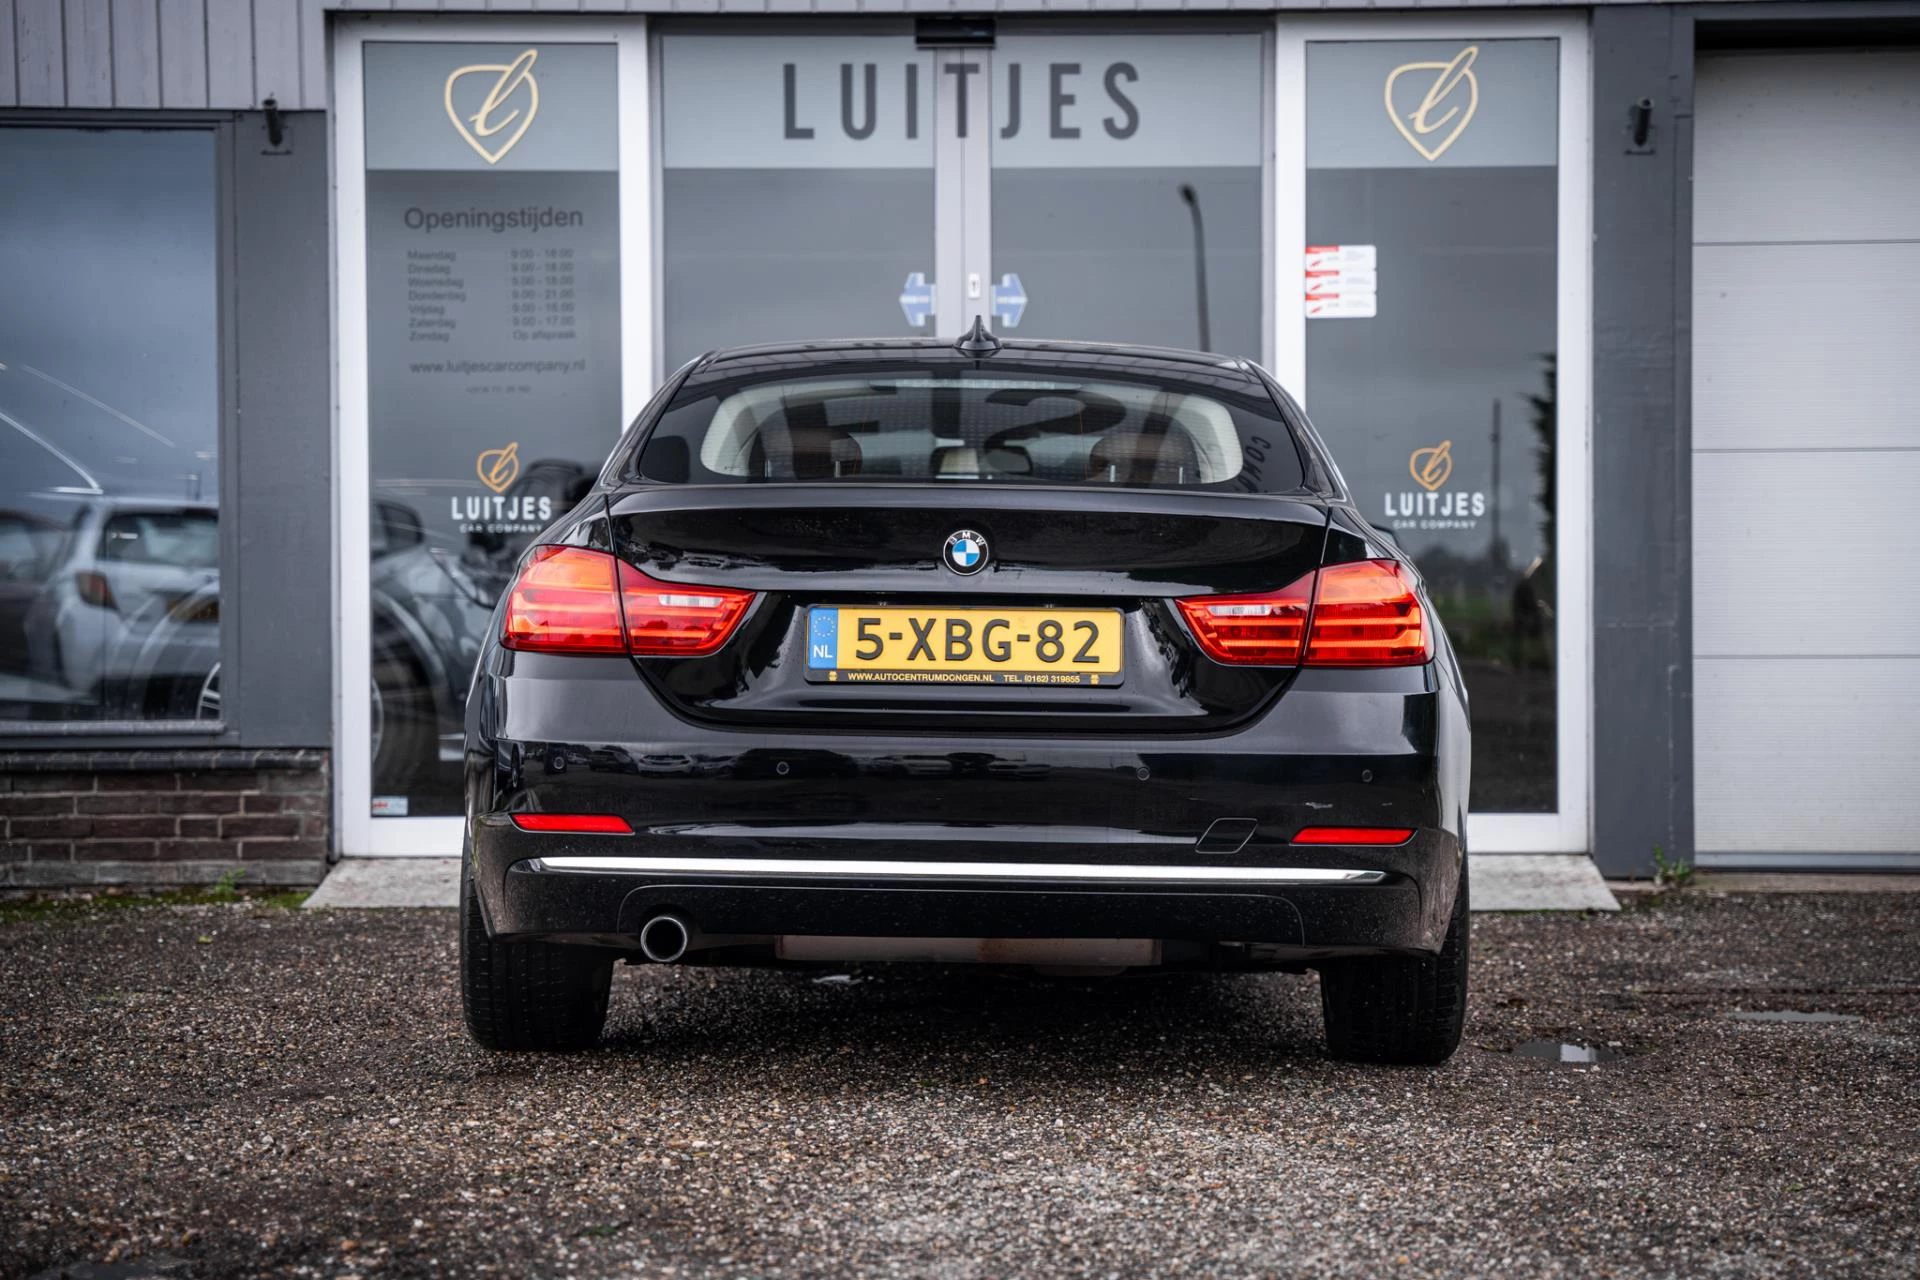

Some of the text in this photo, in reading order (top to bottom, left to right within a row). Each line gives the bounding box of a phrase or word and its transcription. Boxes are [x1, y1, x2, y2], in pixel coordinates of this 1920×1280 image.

[783, 61, 1139, 140] LUITJES
[404, 207, 583, 233] Openingstijden
[409, 359, 586, 375] www.luitjescarcompany.nl
[451, 496, 552, 520] LUITJES
[1384, 492, 1485, 516] LUITJES
[459, 523, 542, 533] CAR COMPANY
[1392, 520, 1477, 530] CAR COMPANY
[948, 531, 986, 546] BMW
[856, 618, 1100, 663] 5-XBG-82
[813, 645, 834, 659] NL
[848, 672, 1081, 684] WWW.AUTOCENTRUMDONGEN.NL TEL. (0162) 319855
